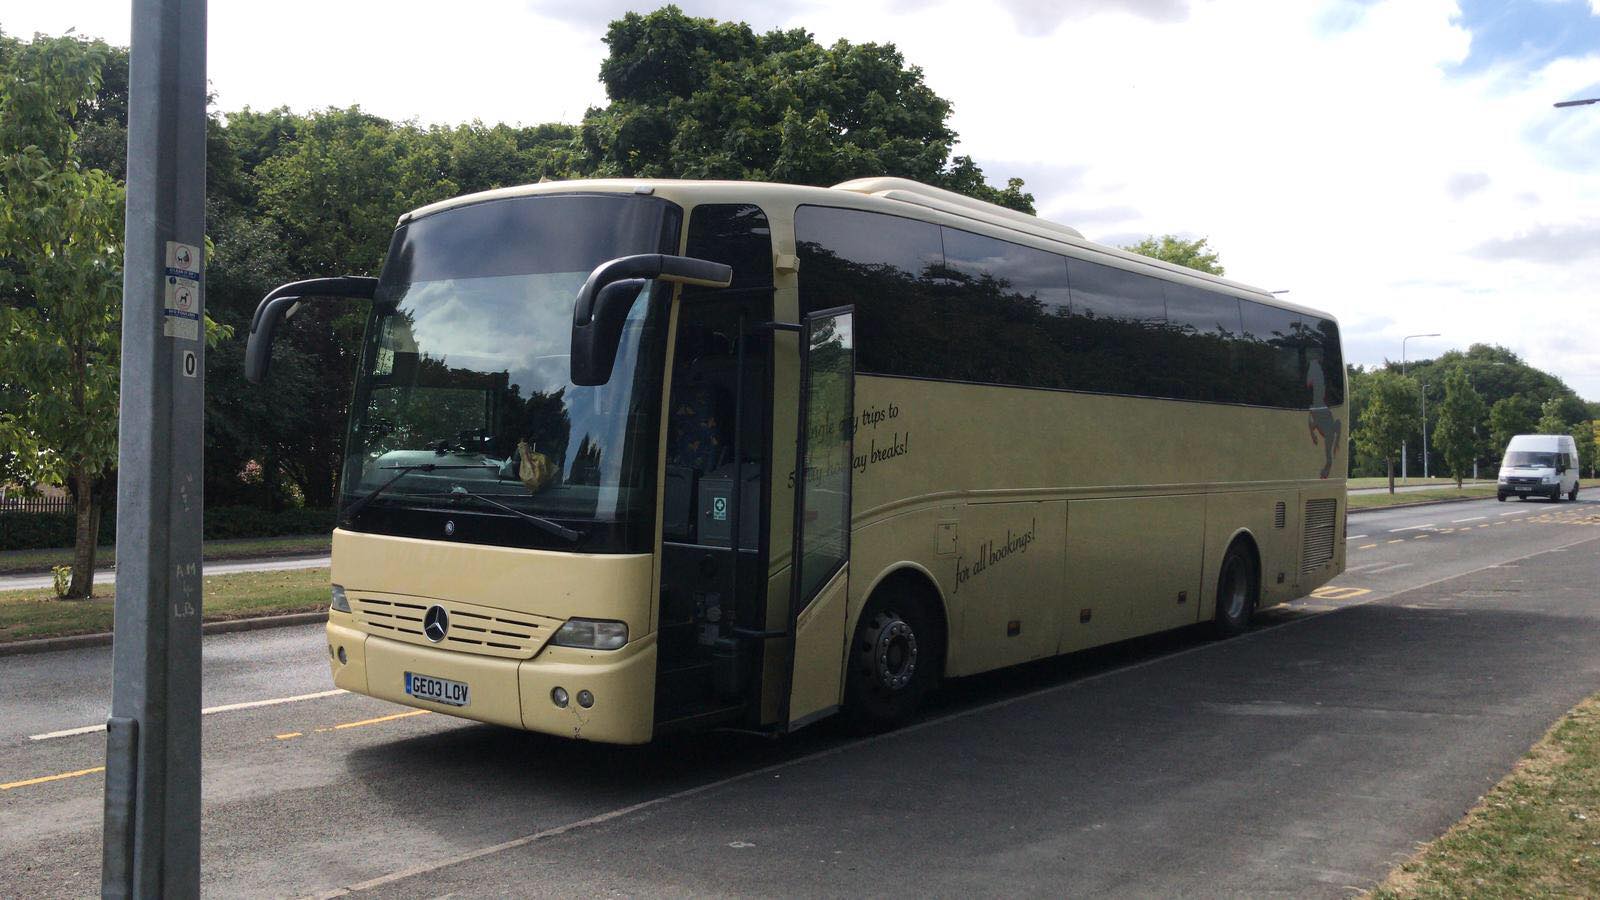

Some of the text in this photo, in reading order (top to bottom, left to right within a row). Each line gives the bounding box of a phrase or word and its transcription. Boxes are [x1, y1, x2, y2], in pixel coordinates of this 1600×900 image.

[862, 405, 886, 429] trips
[889, 402, 899, 419] to
[870, 432, 909, 465] breaks!
[954, 517, 1035, 594] for all bookings!
[413, 676, 469, 702] GE03 LOV
